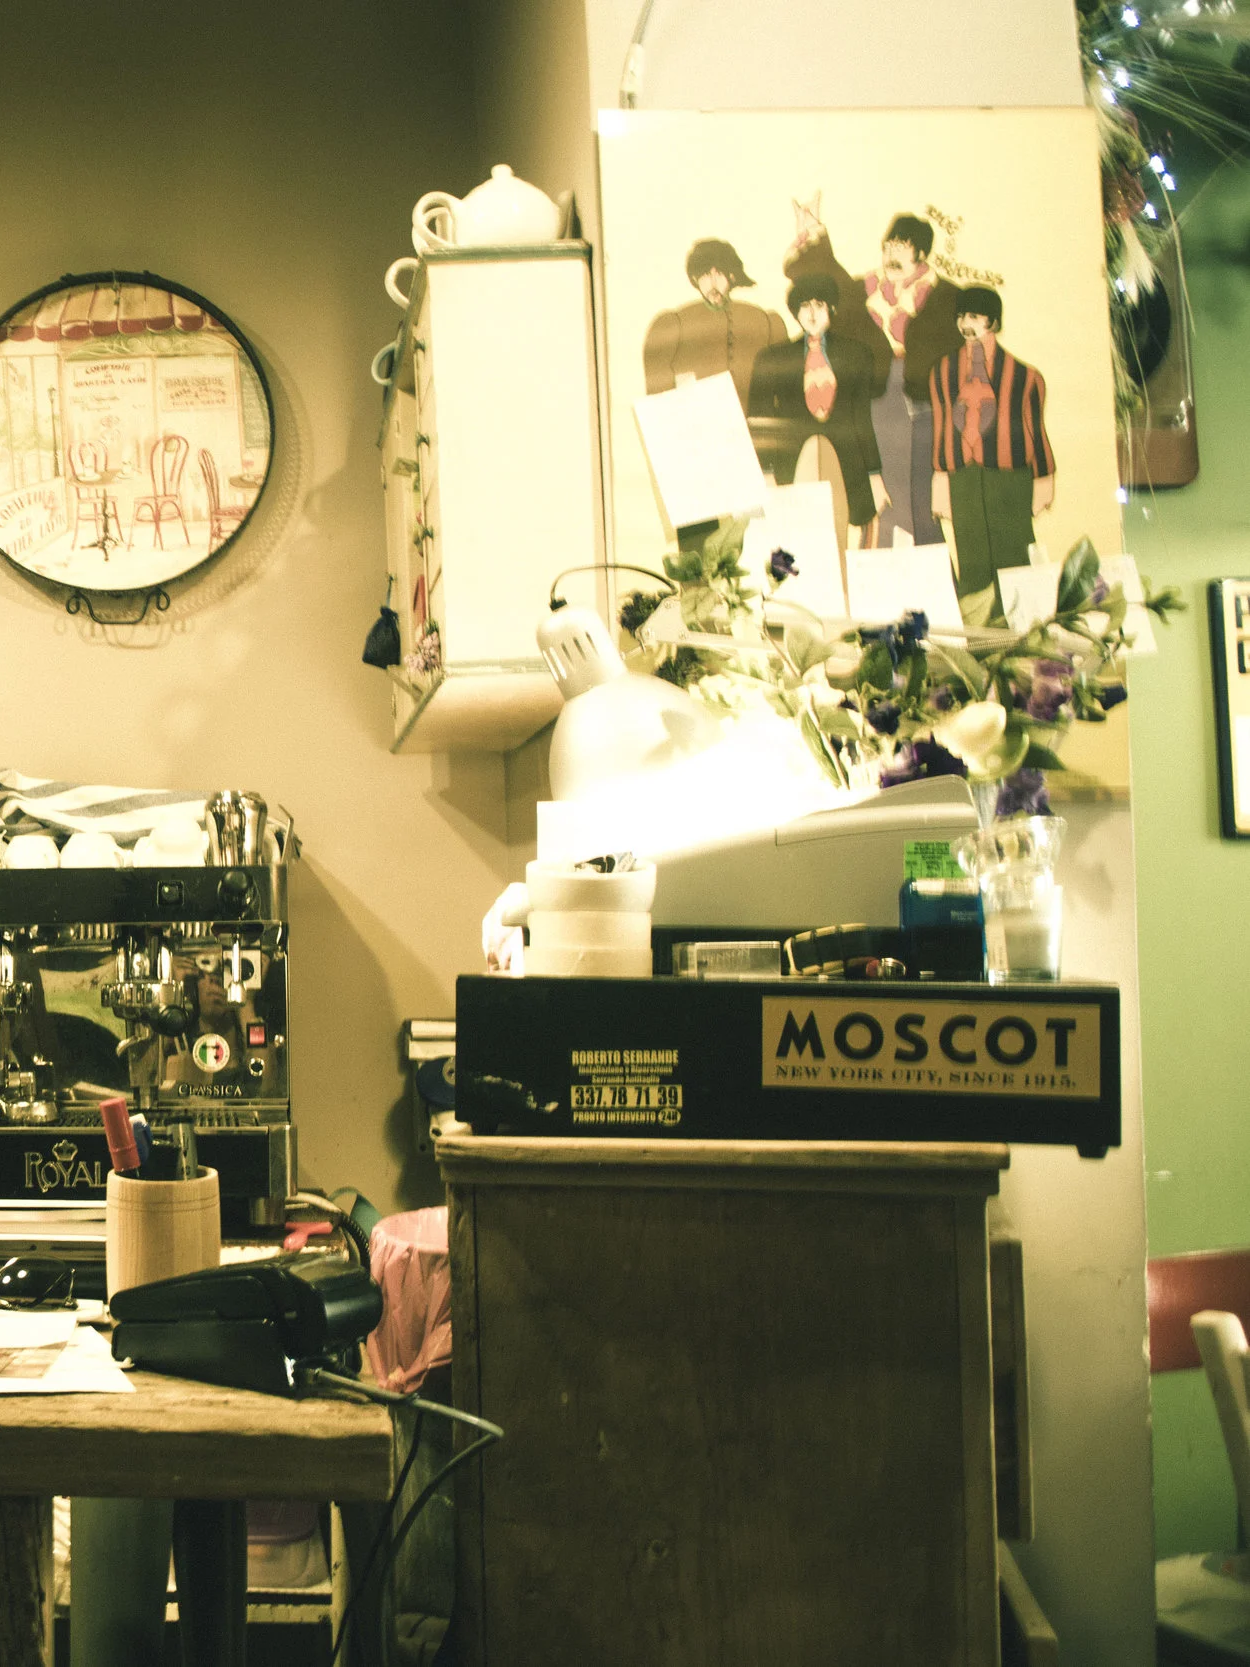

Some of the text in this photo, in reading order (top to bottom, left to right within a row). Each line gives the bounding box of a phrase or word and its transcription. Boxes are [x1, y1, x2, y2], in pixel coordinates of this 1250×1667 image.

[775, 1009, 1077, 1067] MOSCOT
[572, 1049, 679, 1066] ROBERTO SERRANDE
[775, 1064, 821, 1079] NEW
[829, 1066, 883, 1082] YORK
[949, 1071, 1015, 1086] SINCE
[178, 1083, 242, 1098] CLASSICA
[635, 1086, 651, 1105] 71
[657, 1086, 679, 1106] 39
[573, 1111, 606, 1124] PRONTO
[607, 1111, 656, 1123] INTERVENTO
[24, 1151, 108, 1193] ROYAL
